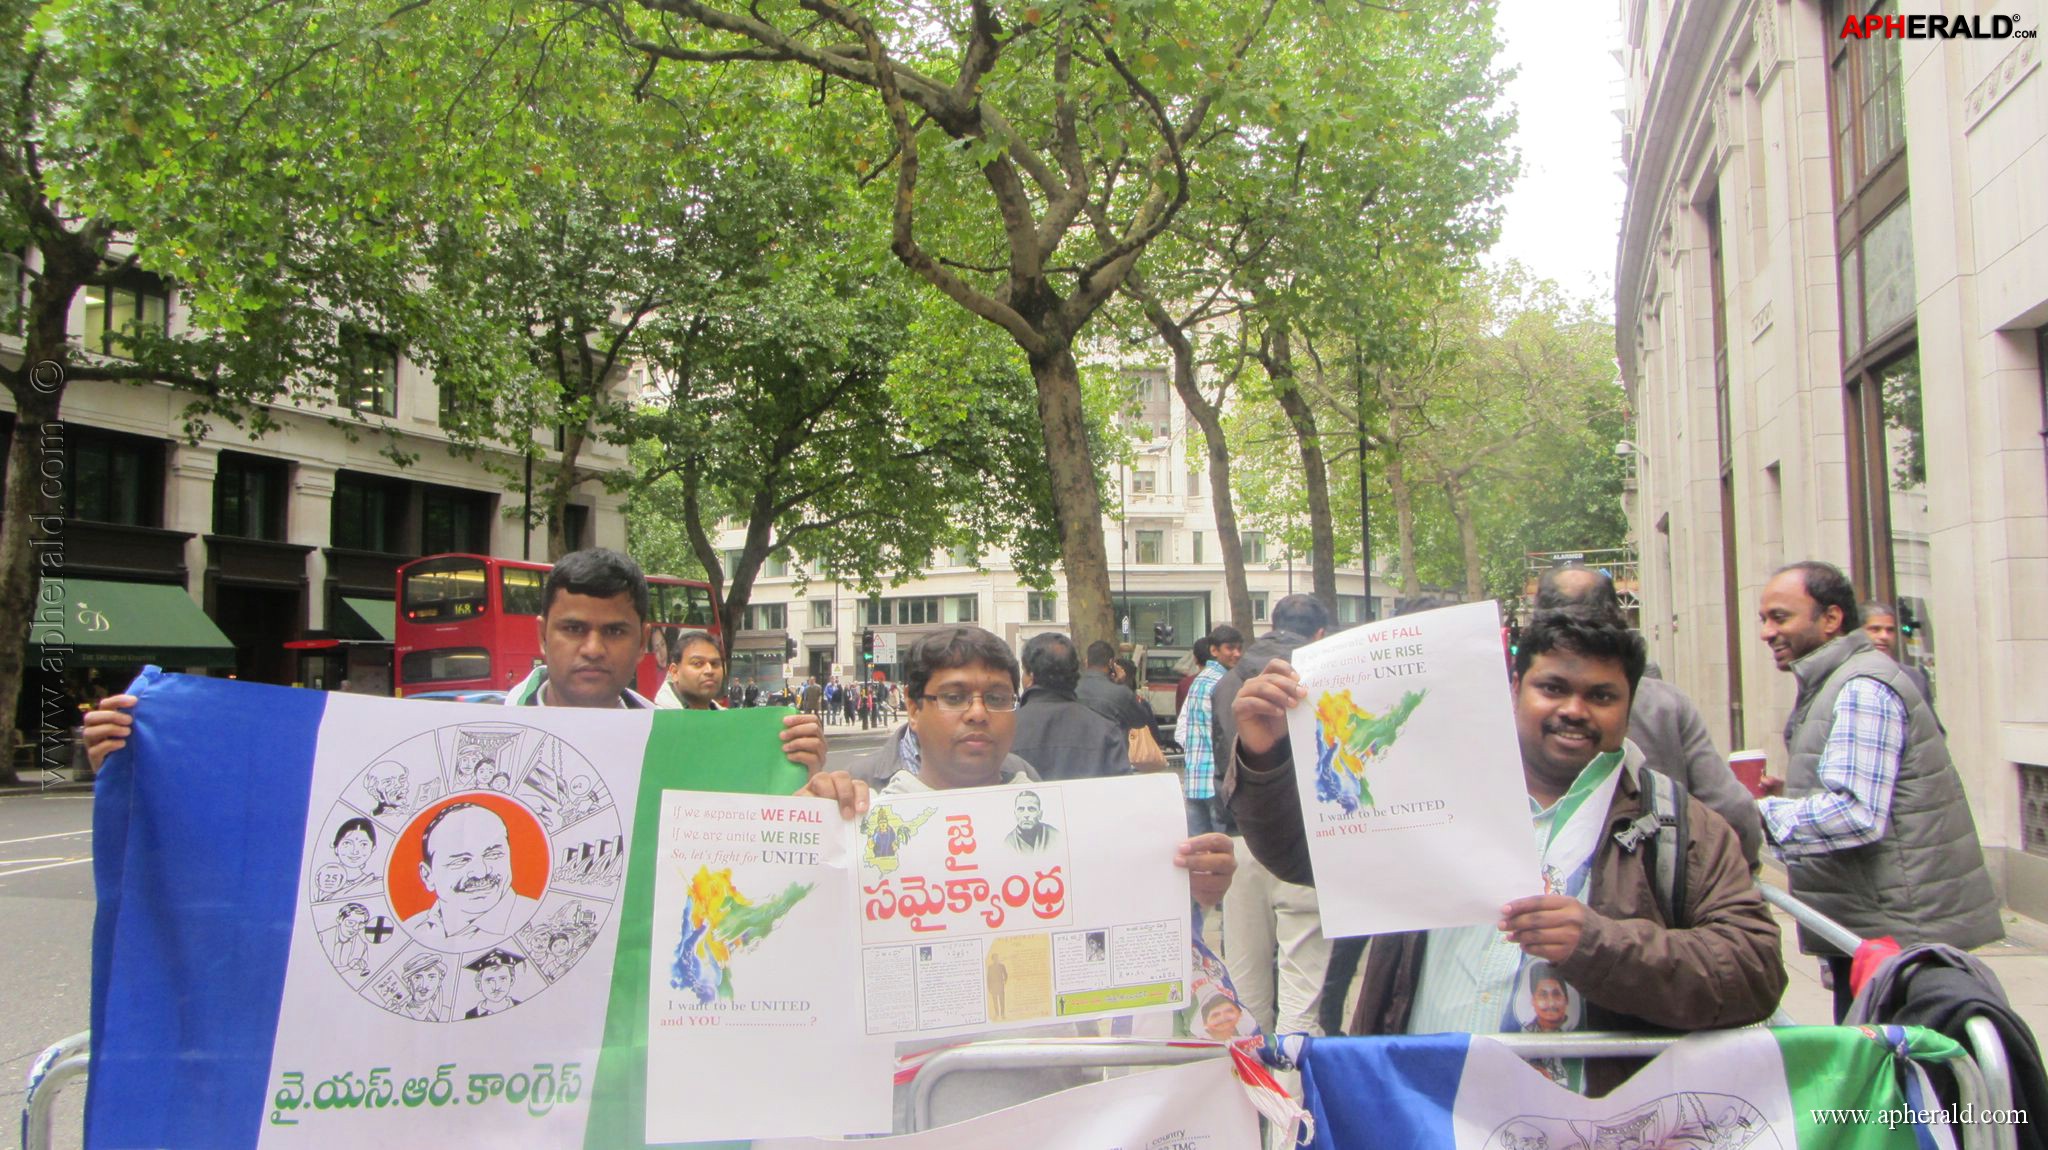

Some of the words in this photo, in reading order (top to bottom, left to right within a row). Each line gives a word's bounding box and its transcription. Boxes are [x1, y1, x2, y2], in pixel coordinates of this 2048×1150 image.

[455, 603, 472, 616] 168
[1368, 630, 1389, 644] WE
[1392, 625, 1423, 640] FALL
[1370, 647, 1392, 662] WE
[1395, 643, 1424, 659] RISE
[1312, 677, 1331, 689] let's
[1330, 674, 1356, 689] fight
[1356, 671, 1372, 686] for
[1374, 661, 1428, 680] UNITE
[684, 807, 701, 818] we
[703, 808, 758, 822] separate
[761, 808, 785, 822] WE
[788, 809, 823, 824] FALL
[1327, 812, 1355, 823] want
[1358, 809, 1370, 819] to
[1373, 807, 1387, 818] be
[1390, 799, 1446, 816] UNITED
[683, 830, 700, 841] we
[702, 831, 723, 841] are
[726, 831, 757, 842] unite
[761, 830, 785, 844] WE
[788, 831, 821, 846] RISE
[1315, 827, 1336, 838] and
[1339, 823, 1368, 836] YOU
[945, 814, 979, 872] జై
[690, 848, 712, 861] let's
[711, 850, 741, 866] fight
[740, 851, 759, 866] for
[762, 849, 820, 866] UNITE
[678, 1002, 709, 1012] want
[714, 1001, 727, 1012] to
[732, 1000, 747, 1012] be
[751, 1000, 811, 1012] UNITED
[660, 1016, 684, 1027] and
[688, 1016, 721, 1027] YOU
[1151, 1128, 1186, 1146] country
